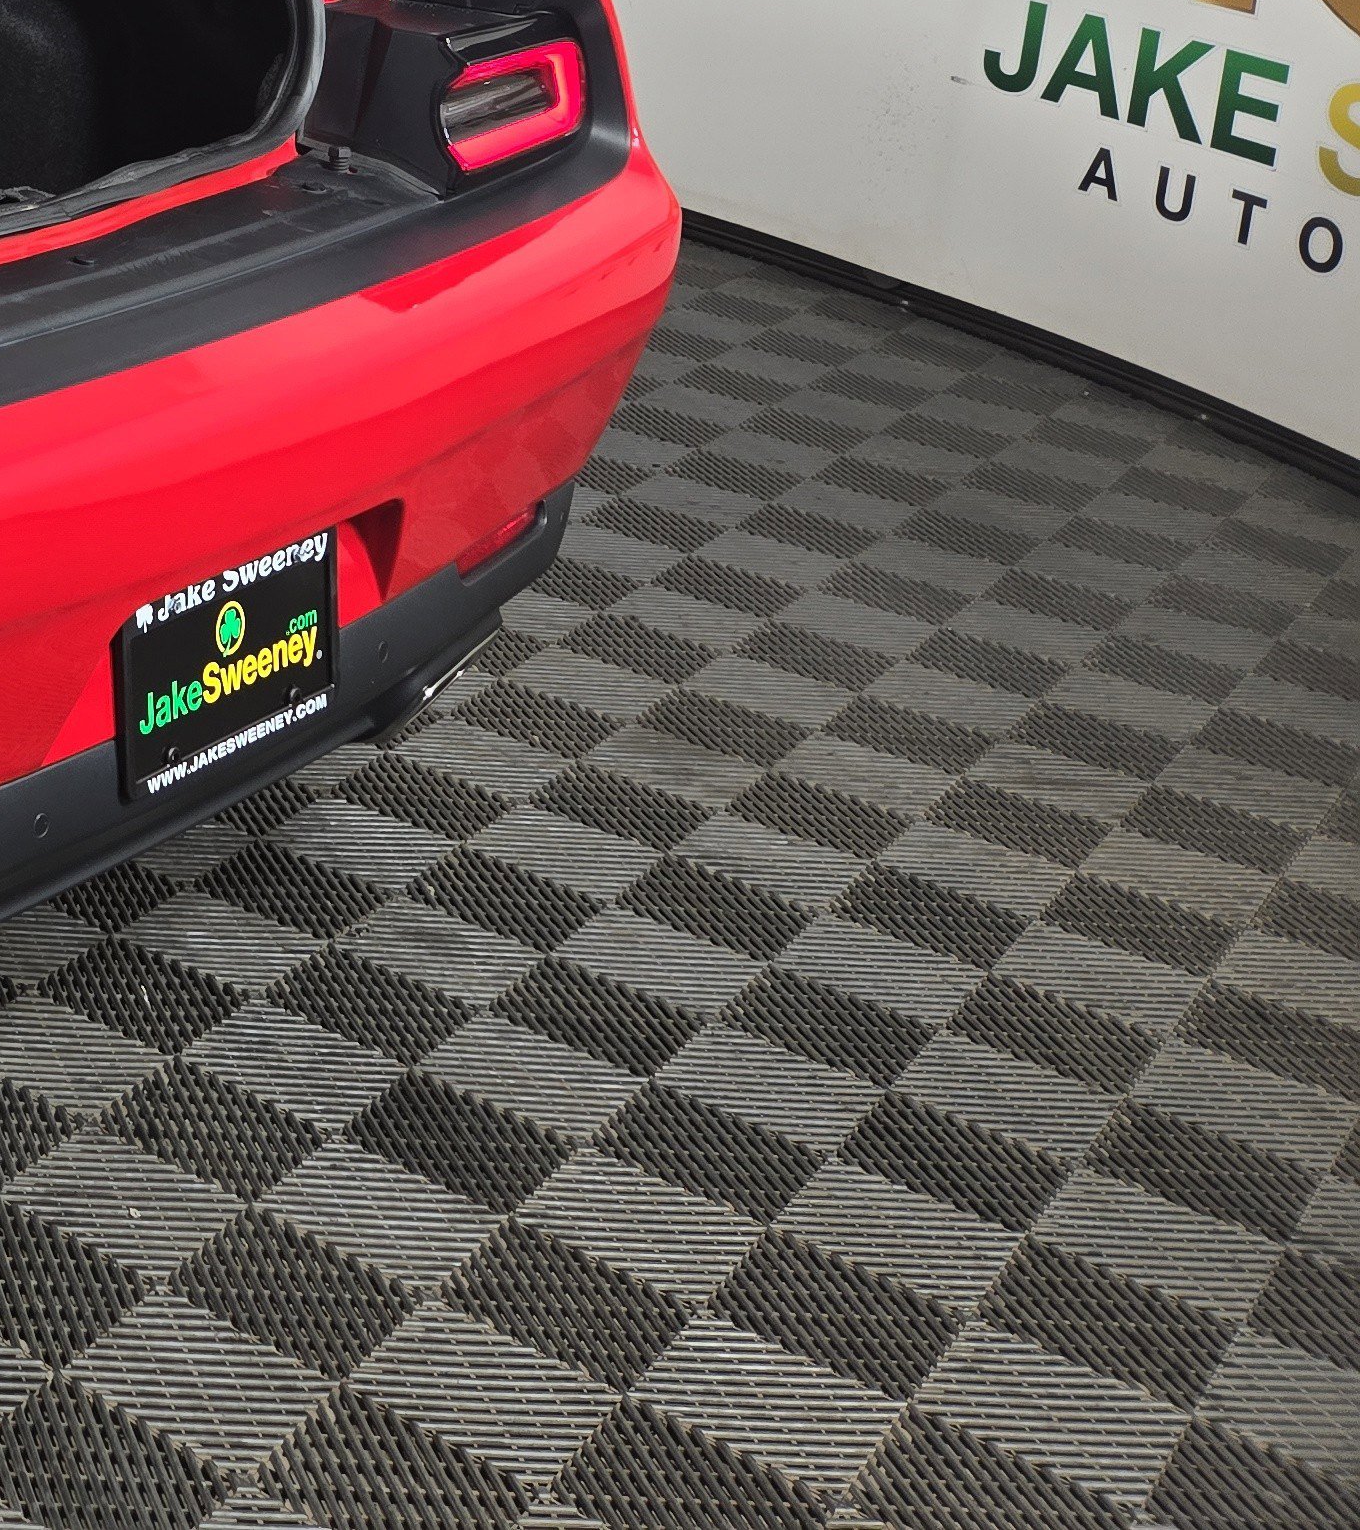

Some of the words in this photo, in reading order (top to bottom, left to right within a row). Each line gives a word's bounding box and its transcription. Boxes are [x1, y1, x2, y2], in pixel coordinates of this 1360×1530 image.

[983, 0, 1291, 168] JAKE
[157, 579, 216, 621] Jake
[222, 532, 328, 593] Sweeney
[146, 693, 328, 794] WWW.JAKESWEENEY.COM
